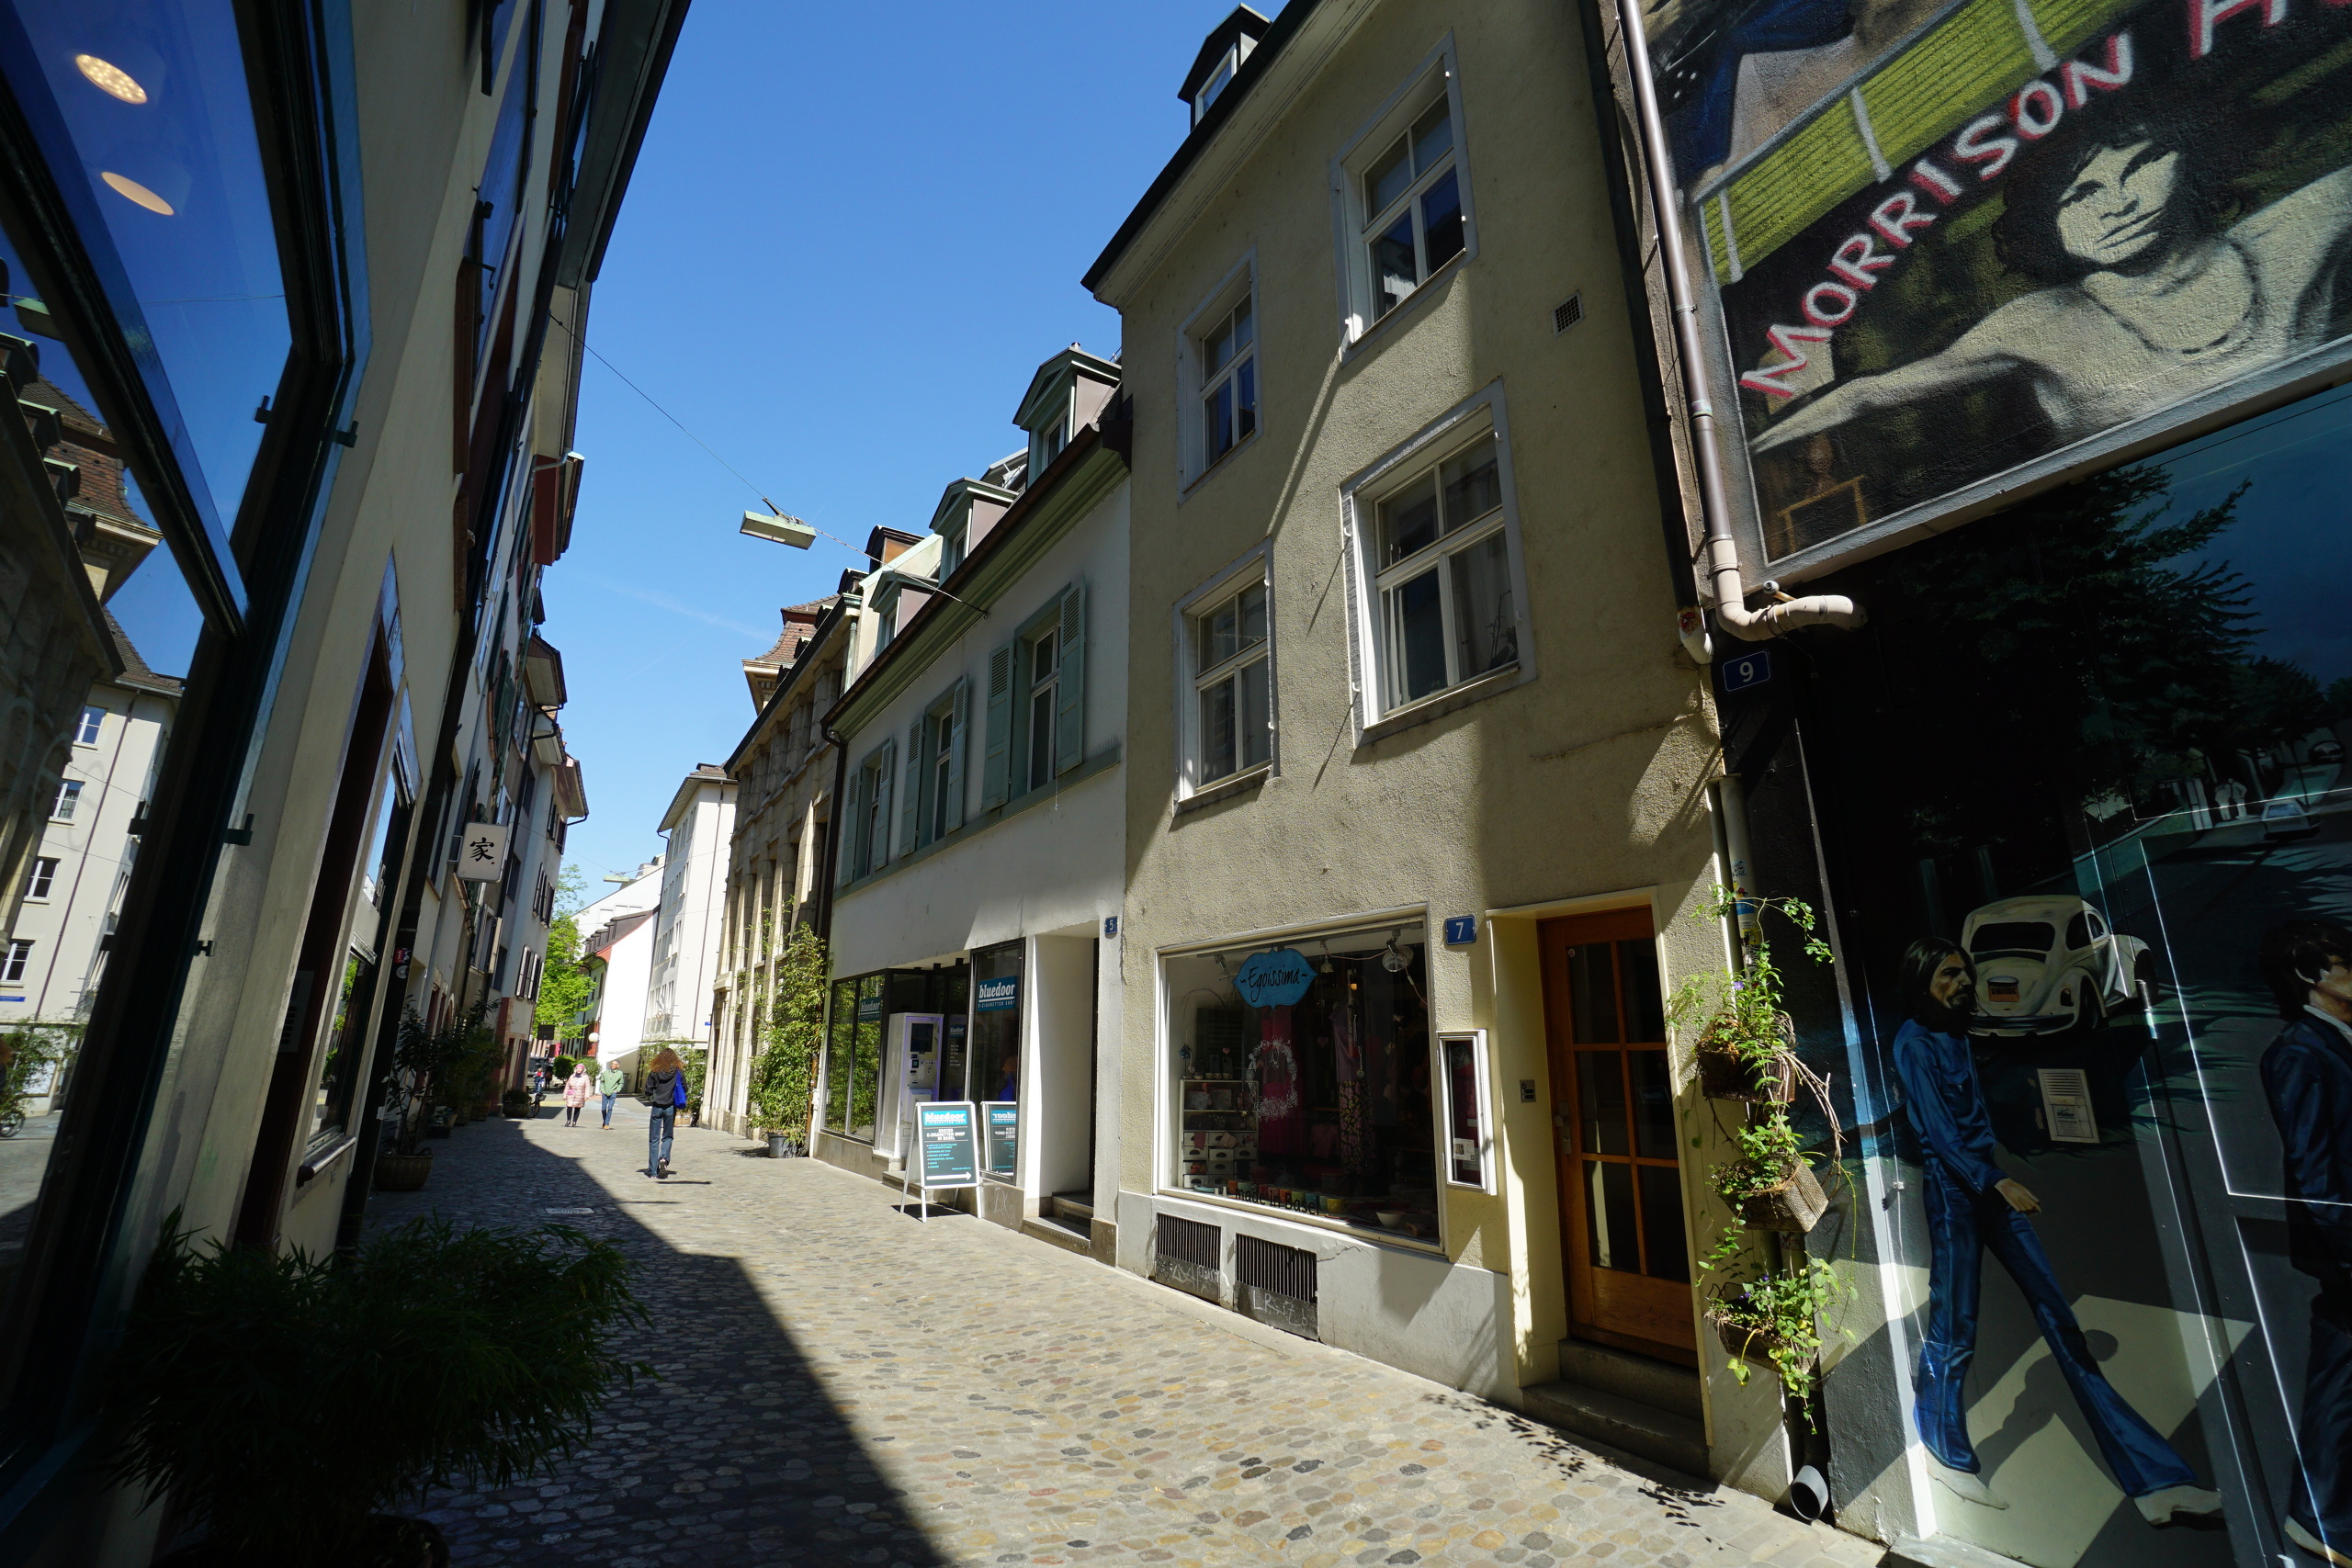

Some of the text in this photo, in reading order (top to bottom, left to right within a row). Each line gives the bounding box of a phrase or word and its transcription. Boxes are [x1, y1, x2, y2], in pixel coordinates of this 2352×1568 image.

[1739, 30, 2134, 399] MORRISON
[1739, 661, 1754, 683] 9
[469, 837, 494, 863] 家
[1455, 921, 1464, 940] 7
[978, 981, 1016, 998] bluedoor
[1248, 964, 1300, 1002] Egoissima
[1235, 1187, 1319, 1215] made in Basel
